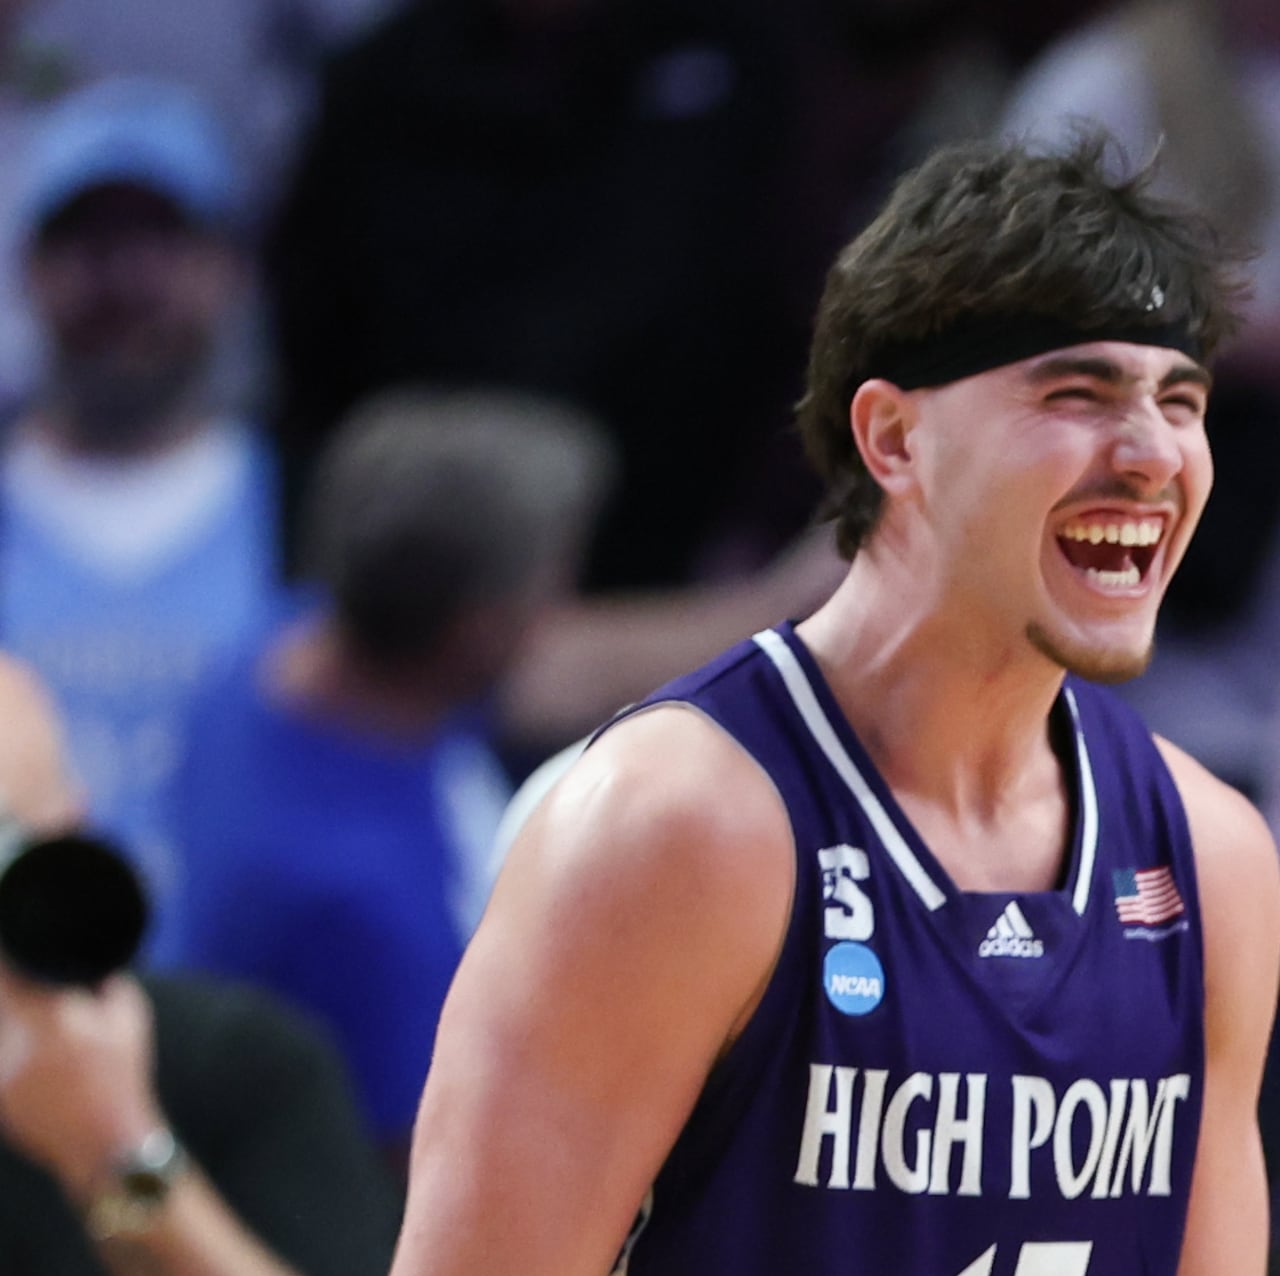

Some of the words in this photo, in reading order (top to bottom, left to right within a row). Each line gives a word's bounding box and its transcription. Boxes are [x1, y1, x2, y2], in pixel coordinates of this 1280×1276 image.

[978, 939, 1044, 958] adidas
[830, 973, 882, 998] NCAA
[793, 1062, 987, 1197] HIGH
[1008, 1073, 1190, 1200] POINT
